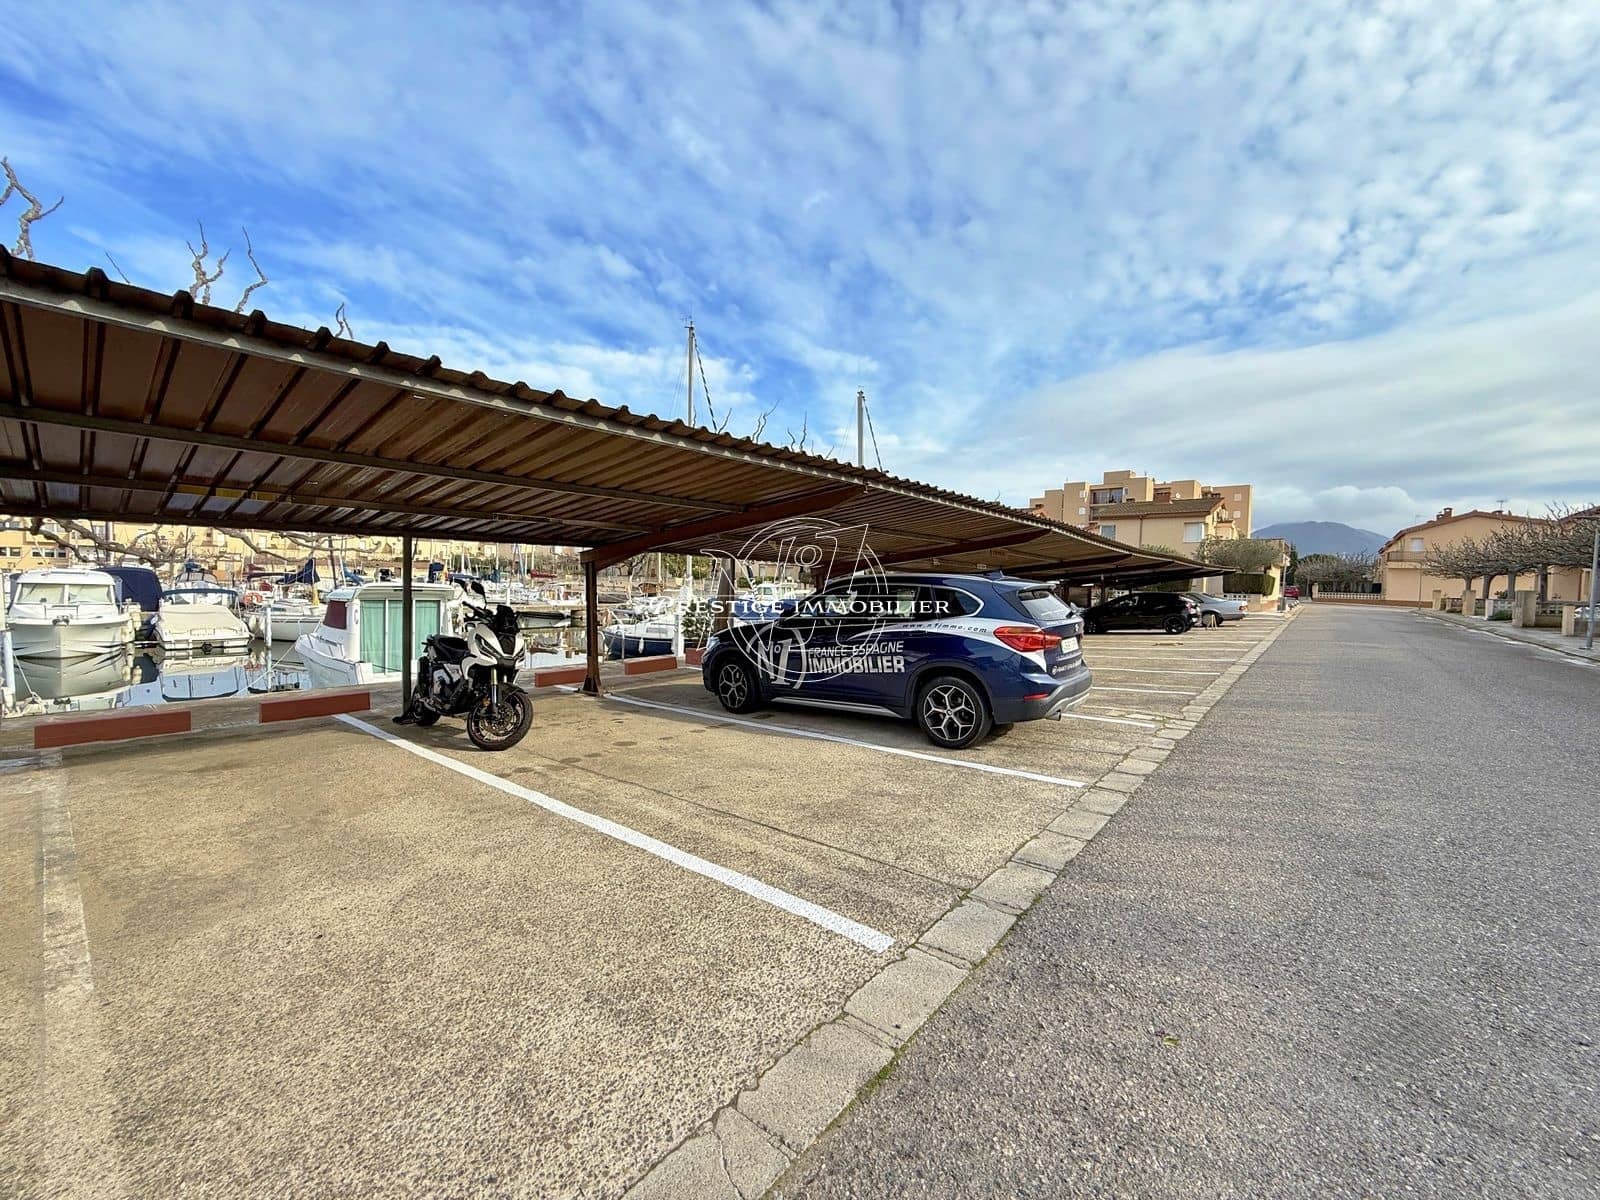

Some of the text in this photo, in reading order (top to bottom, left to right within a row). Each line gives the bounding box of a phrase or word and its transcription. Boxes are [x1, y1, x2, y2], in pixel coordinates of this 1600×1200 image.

[808, 640, 905, 658] FRANCE ESPAGNE
[808, 655, 906, 674] IMMOBILIER
